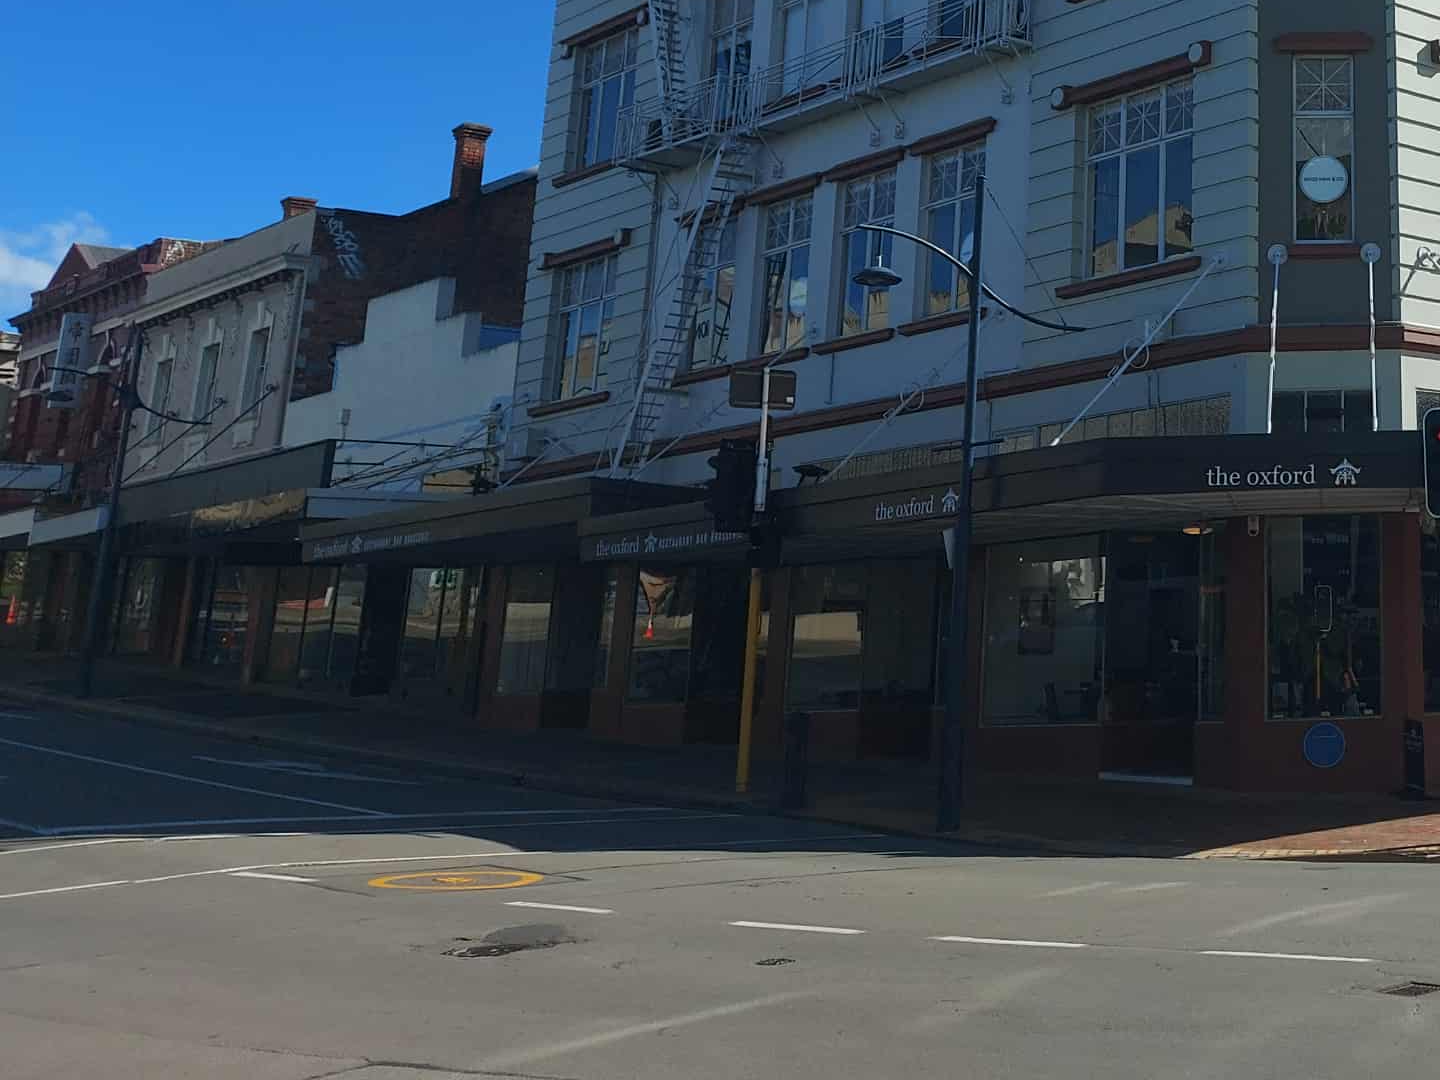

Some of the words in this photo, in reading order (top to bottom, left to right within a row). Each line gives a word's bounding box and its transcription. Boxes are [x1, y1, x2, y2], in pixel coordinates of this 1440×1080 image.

[1206, 466, 1241, 486] the
[1247, 464, 1317, 486] oxford
[875, 501, 894, 521] the
[896, 495, 935, 518] oxford
[611, 536, 640, 554] oxford
